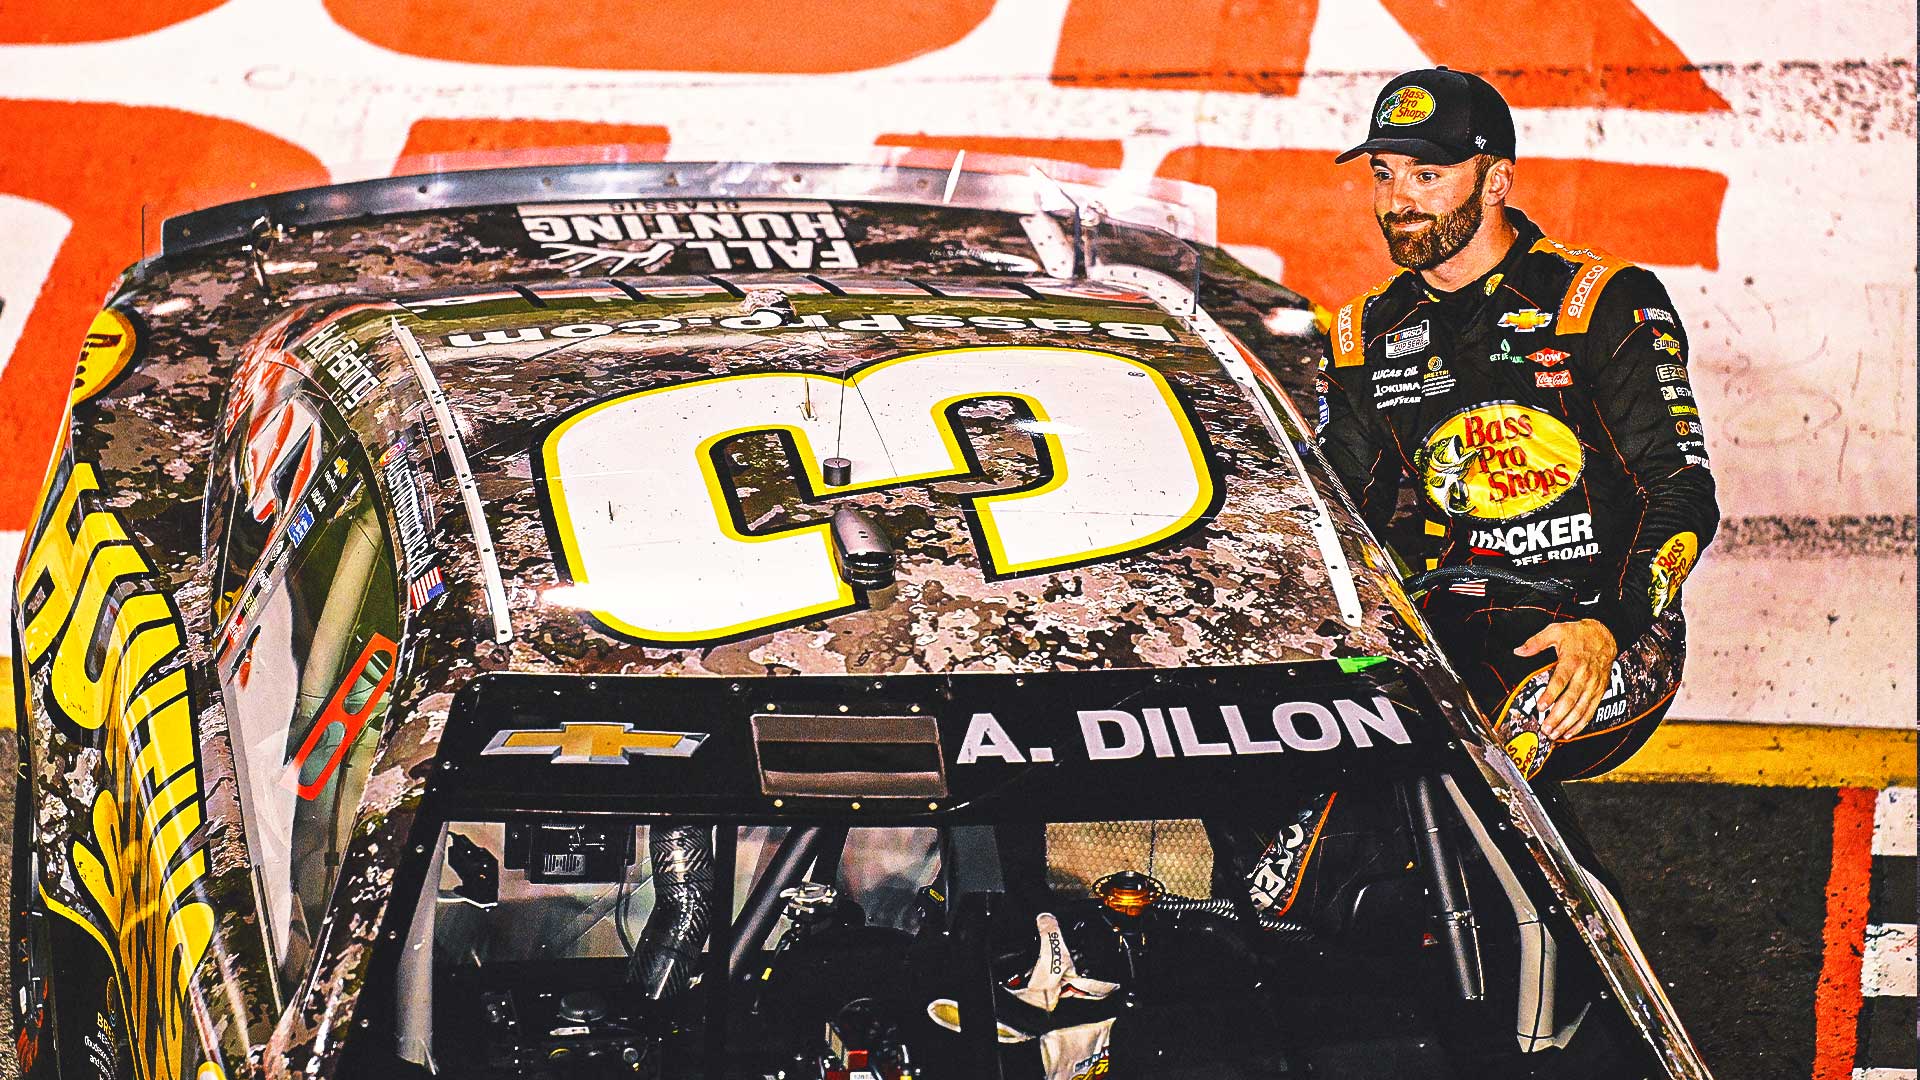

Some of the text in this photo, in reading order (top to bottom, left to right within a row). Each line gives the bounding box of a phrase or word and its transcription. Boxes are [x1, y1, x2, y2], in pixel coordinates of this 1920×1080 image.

[1399, 99, 1418, 109] Pro
[1401, 88, 1425, 100] Bass
[1397, 107, 1427, 119] Shops
[522, 213, 845, 242] HUNTING
[686, 240, 859, 270] FALL
[1567, 264, 1609, 319] sparco
[448, 309, 1178, 348] BassPro.com
[1536, 352, 1561, 362] DOW
[1372, 369, 1402, 380] LUCAS
[1463, 413, 1534, 449] Bass
[1477, 445, 1528, 474] Pro
[530, 345, 1225, 647] 3
[1487, 463, 1571, 502] Shops
[1658, 538, 1686, 572] Bass
[1596, 699, 1627, 723] ROAD
[956, 696, 1412, 764] A. DILLON
[1048, 932, 1062, 975] sparco
